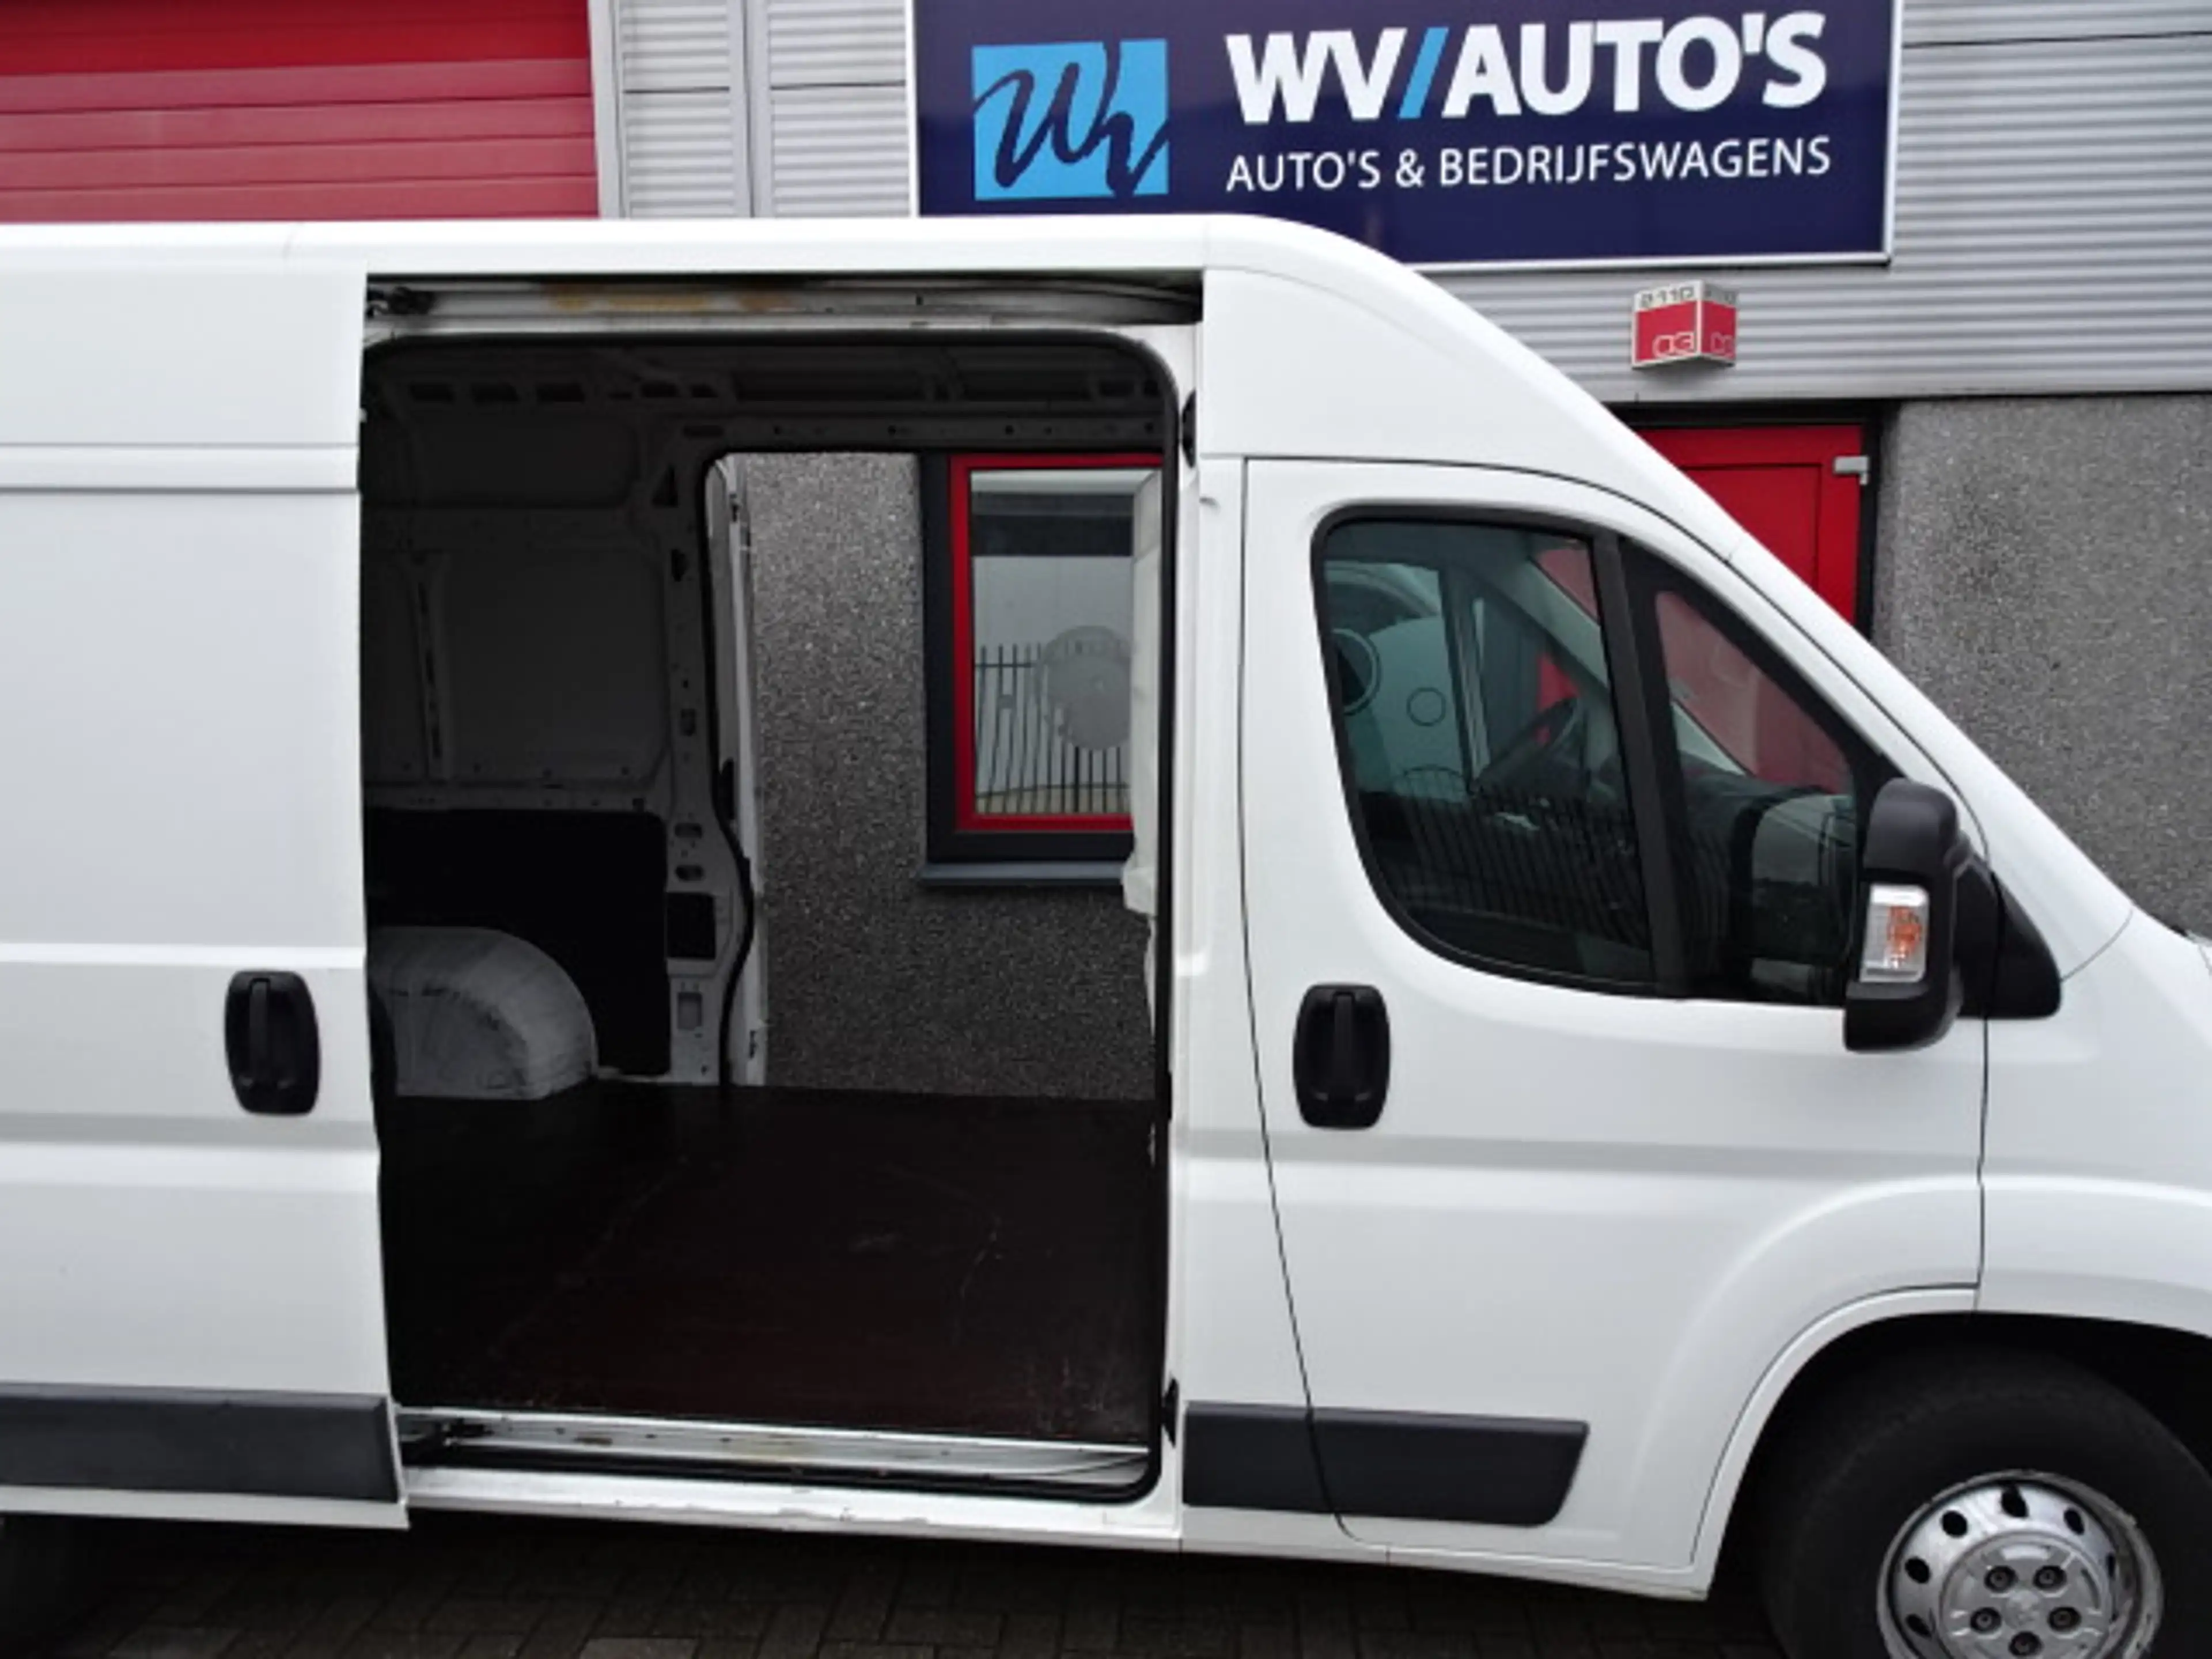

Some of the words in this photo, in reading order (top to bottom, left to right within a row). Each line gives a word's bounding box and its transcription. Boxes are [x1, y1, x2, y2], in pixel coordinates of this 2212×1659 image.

[1227, 151, 1380, 191] AUTO'S
[1395, 149, 1425, 188] &
[1440, 137, 1830, 185] BEDRIJFSWAGENS
